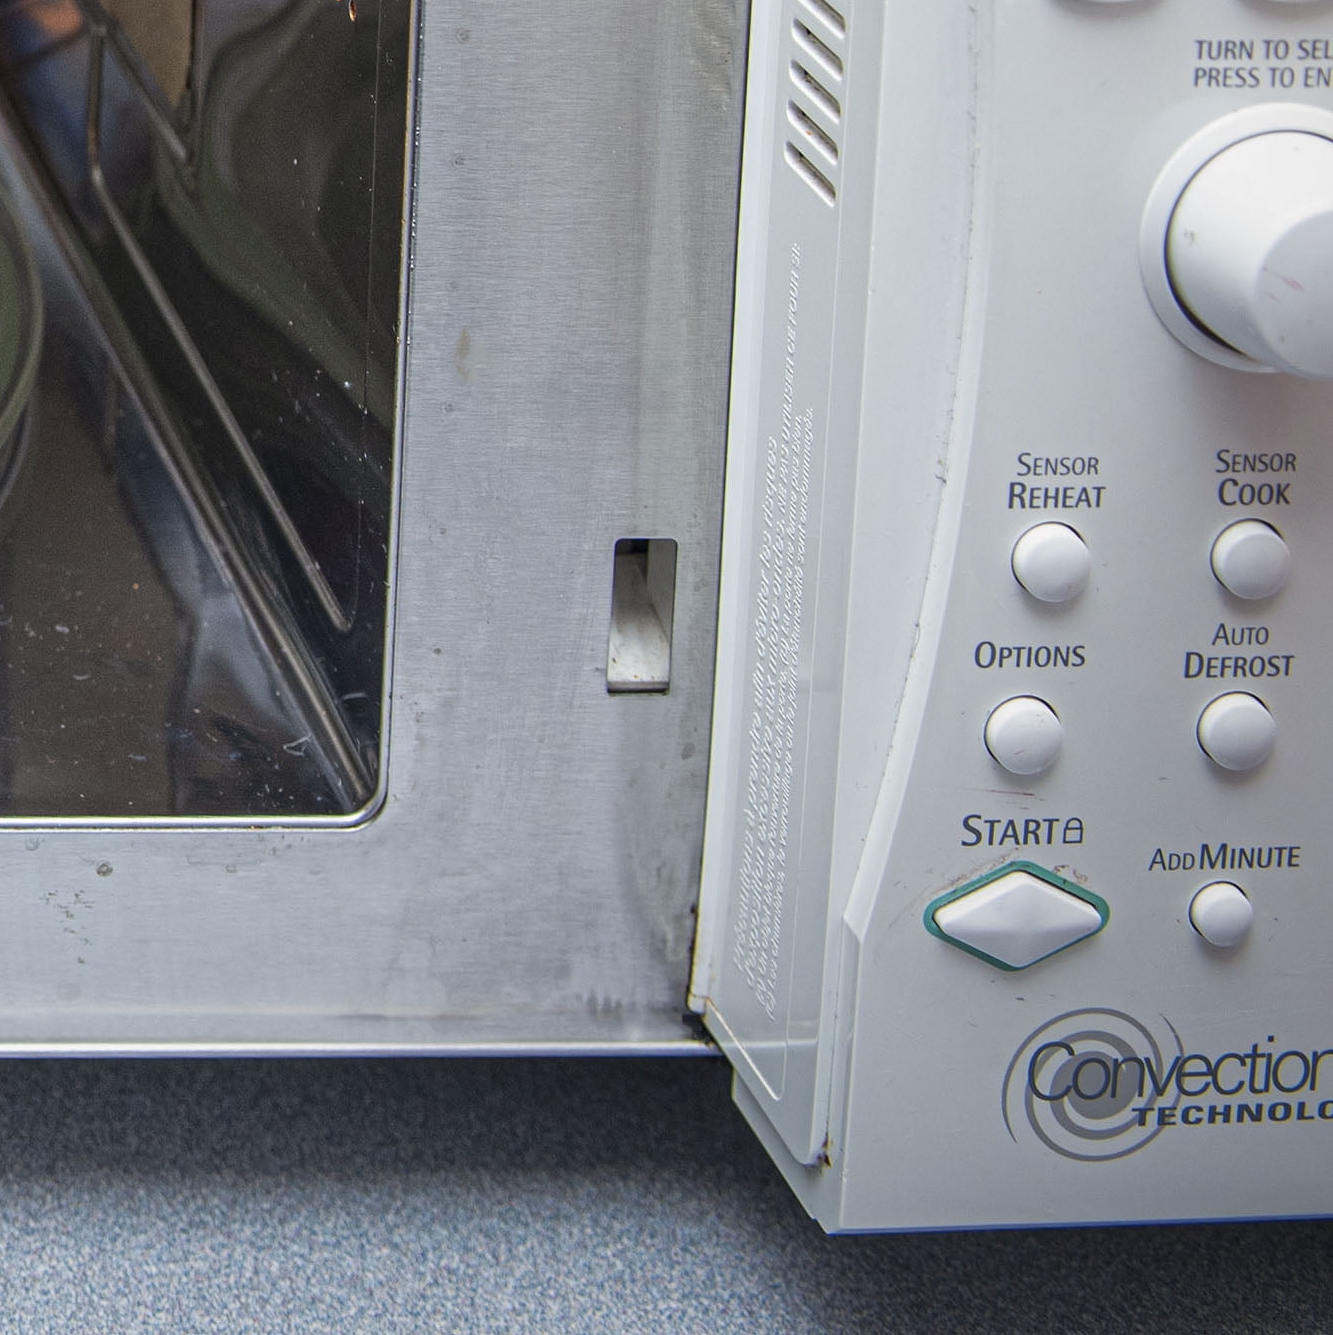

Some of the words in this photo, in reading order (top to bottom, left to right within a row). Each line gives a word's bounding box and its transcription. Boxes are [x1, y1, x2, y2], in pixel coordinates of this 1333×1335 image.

[1195, 39, 1254, 60] TURN
[1262, 39, 1289, 60] TO
[1194, 67, 1260, 88] PRESS
[1268, 67, 1295, 88] TO
[1017, 452, 1099, 477] SENSOR
[1216, 449, 1297, 473] SENSOR
[1008, 482, 1106, 509] REHEAT
[1219, 478, 1291, 506] COOK
[1212, 623, 1269, 646] AUTO
[974, 641, 1086, 669] OPTIONS
[1184, 651, 1295, 679] DEFROST
[961, 814, 1060, 847] START
[1148, 848, 1195, 871] ADD
[1198, 843, 1300, 870] MINUTE
